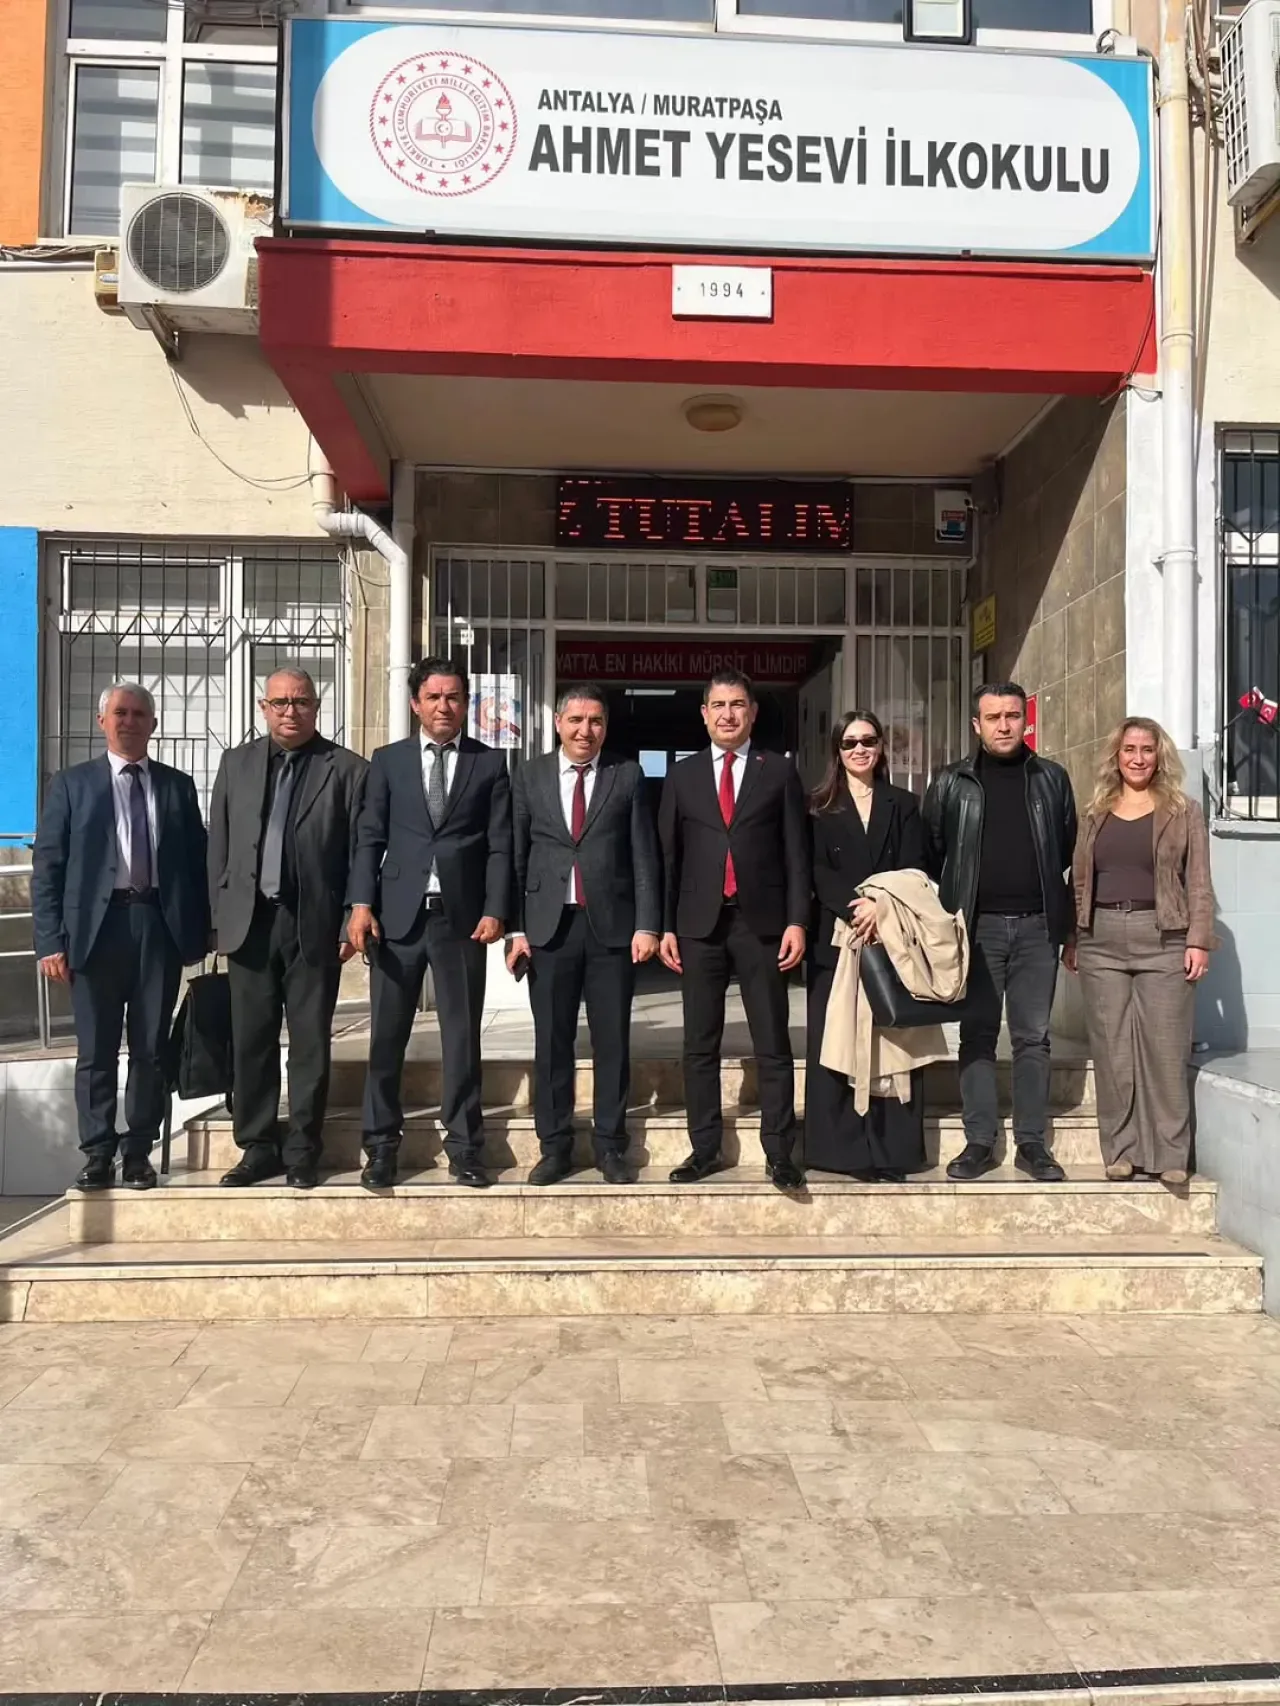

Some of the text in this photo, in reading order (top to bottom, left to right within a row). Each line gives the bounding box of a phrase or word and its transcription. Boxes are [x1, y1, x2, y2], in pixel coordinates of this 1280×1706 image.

[397, 77, 491, 168] TÜRKİYE CUMHURİYETİ MİLLİ EĞİTİM BAKANLIĞI
[537, 88, 783, 125] ANTALYA / MURATPAŞA
[528, 123, 1110, 194] AHMET YESEVİ İLKOKULU
[701, 282, 743, 298] 1994
[605, 653, 626, 673] EN
